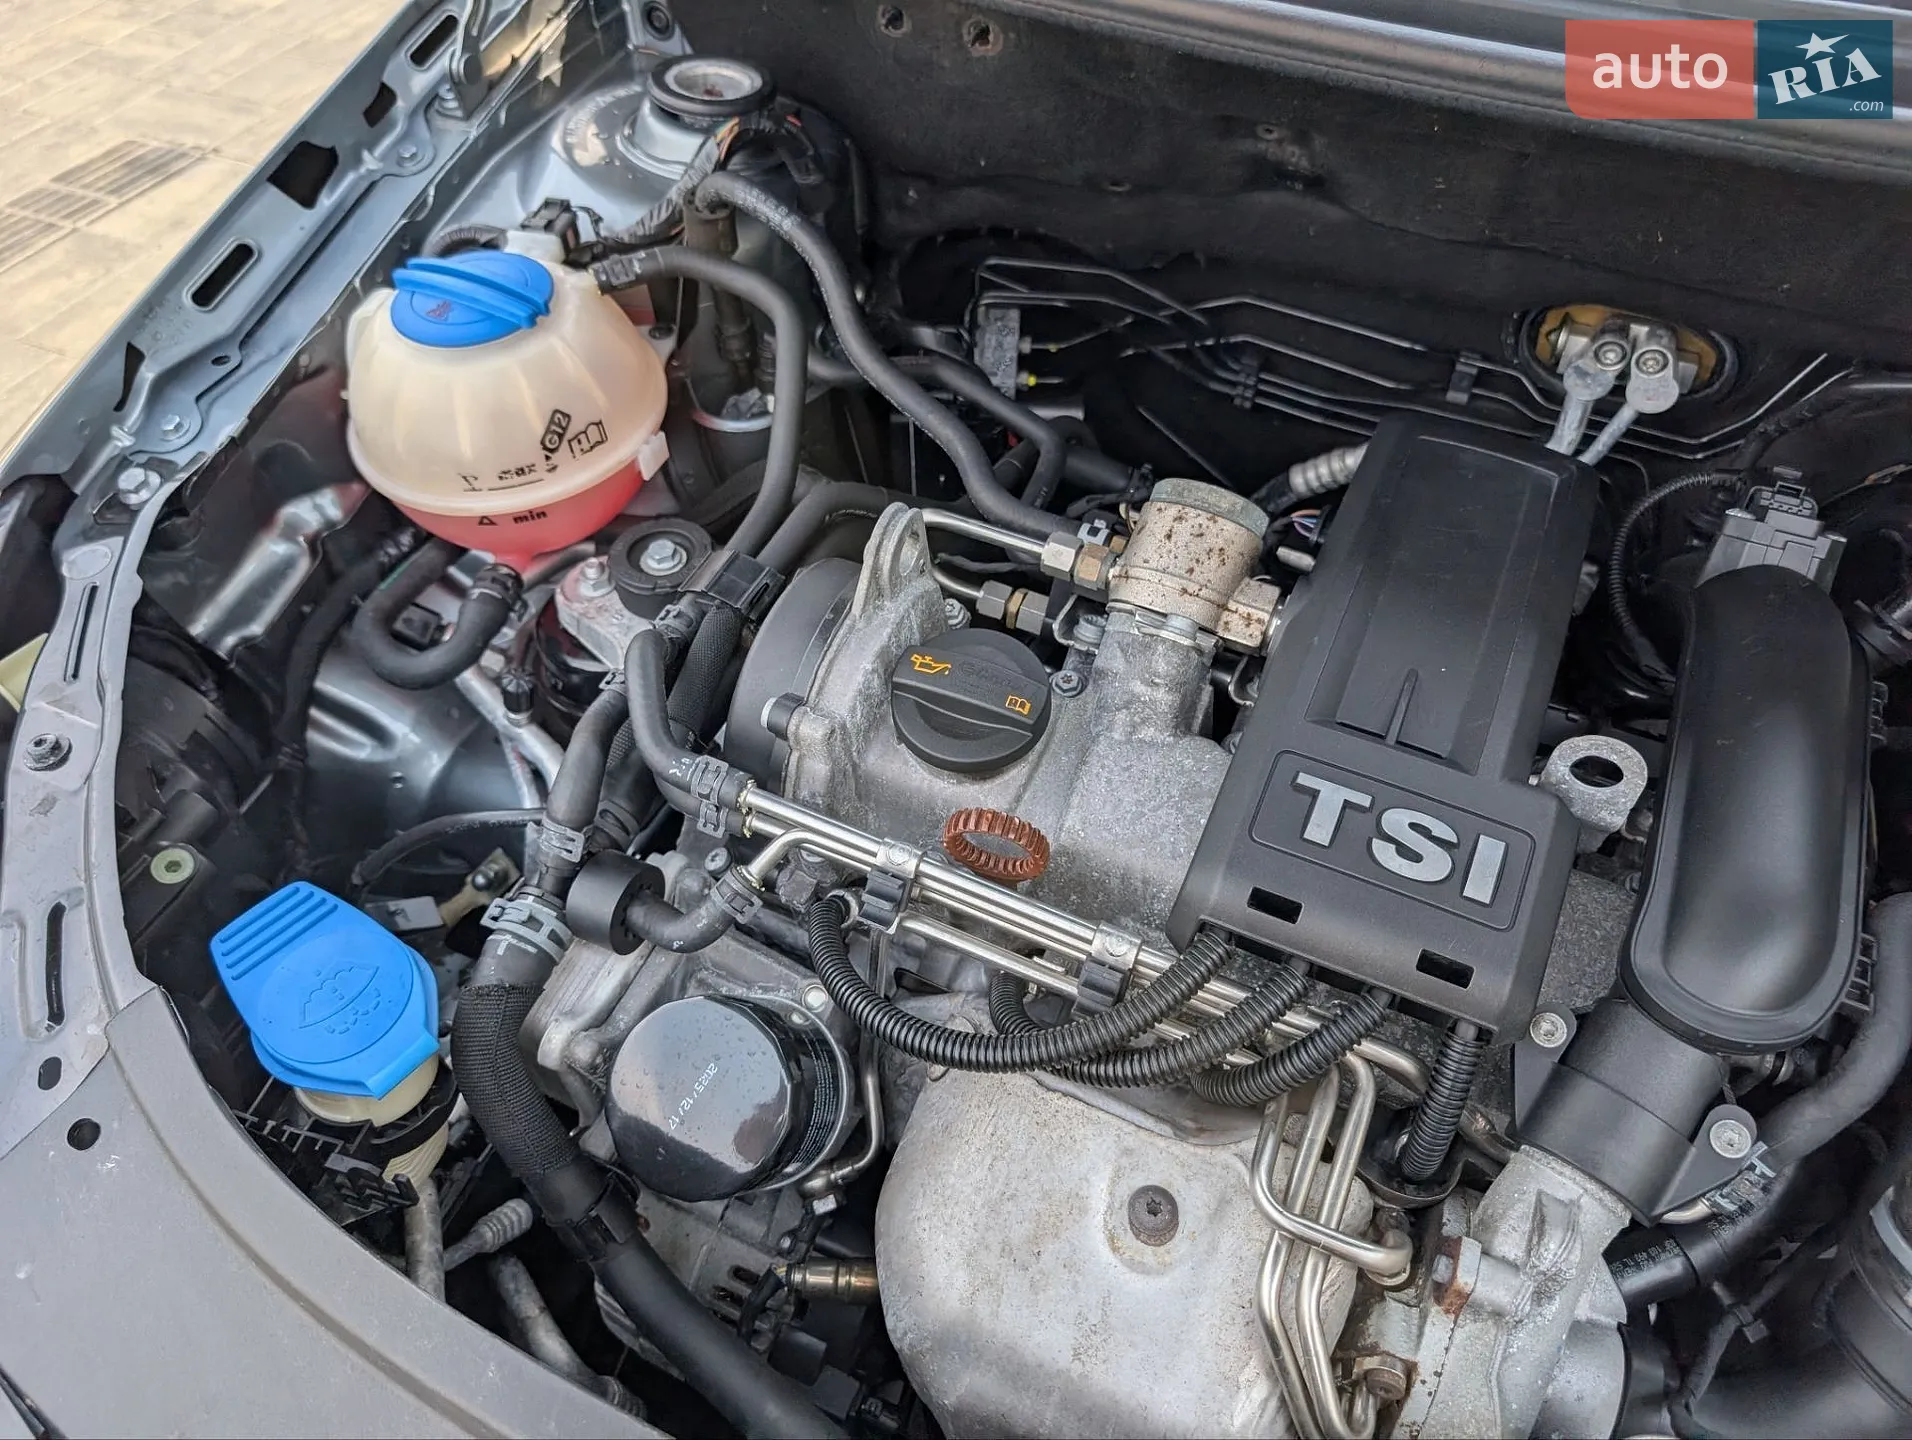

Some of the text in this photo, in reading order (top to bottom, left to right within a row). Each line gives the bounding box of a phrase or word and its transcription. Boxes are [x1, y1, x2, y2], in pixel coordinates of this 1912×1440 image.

[545, 413, 566, 449] G12
[513, 510, 547, 524] min
[1293, 771, 1507, 905] TSI
